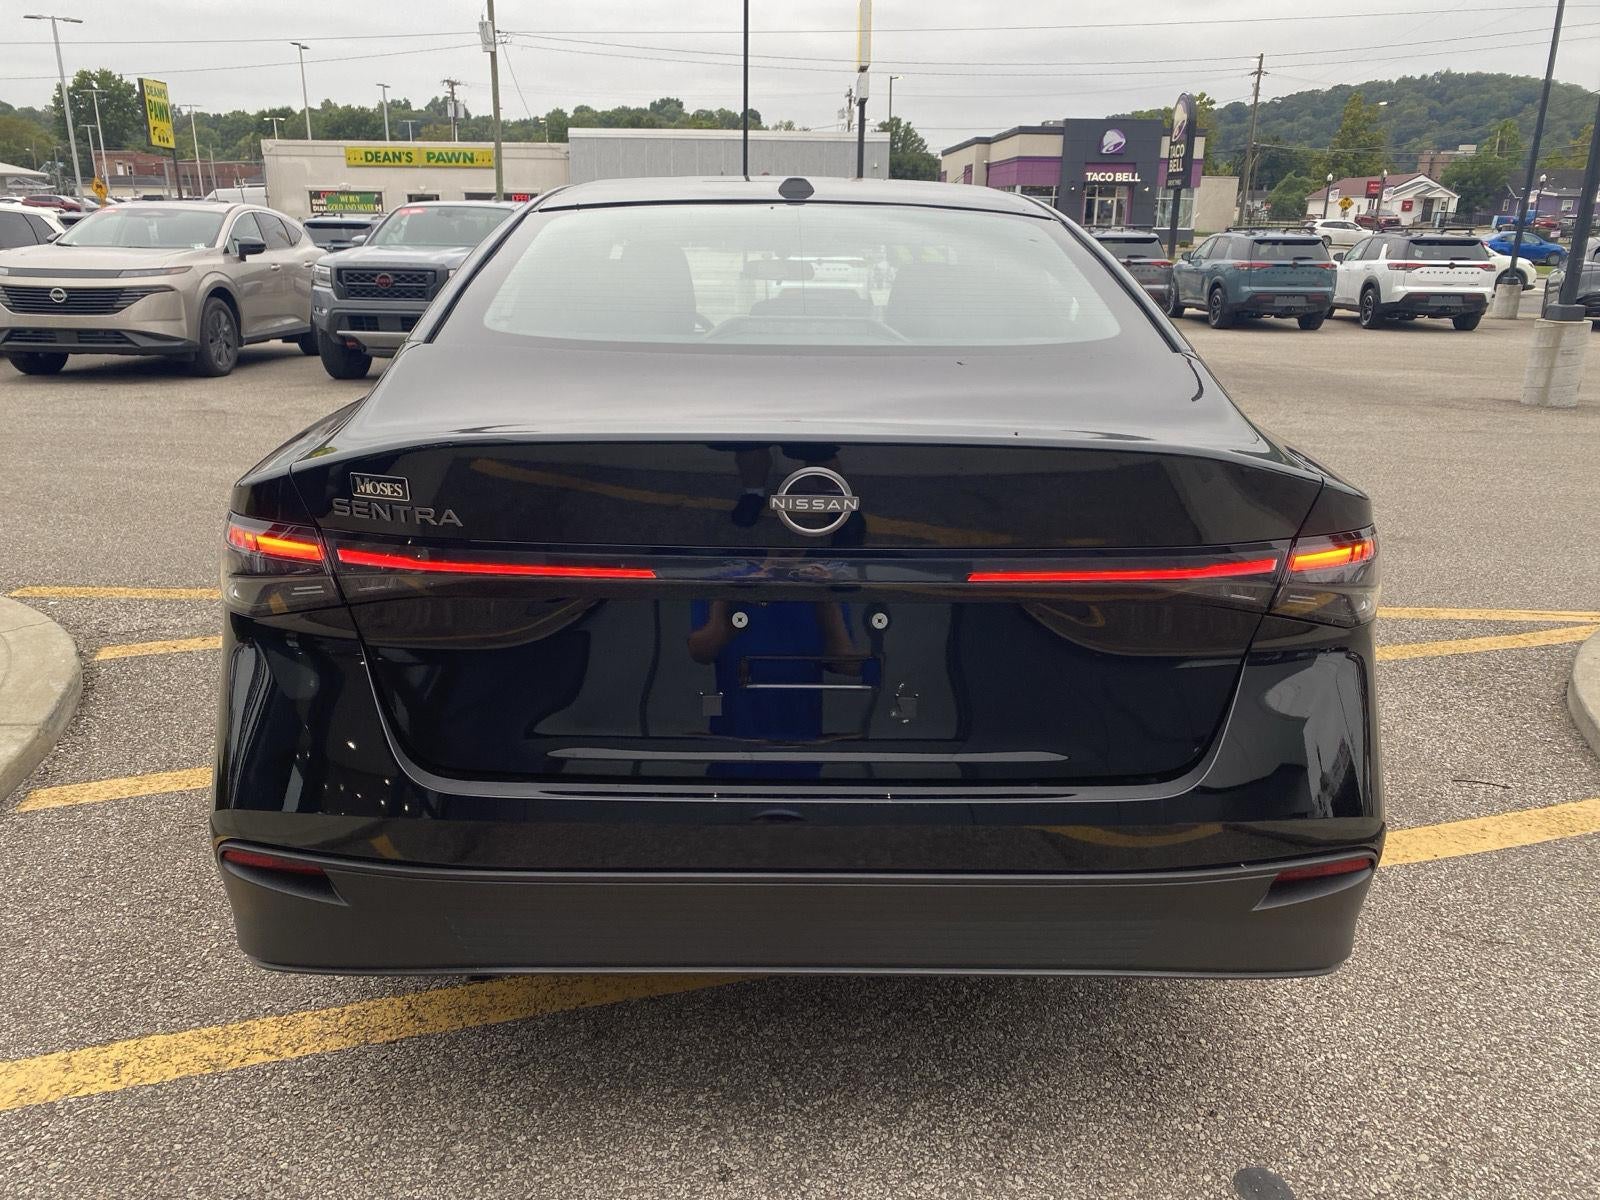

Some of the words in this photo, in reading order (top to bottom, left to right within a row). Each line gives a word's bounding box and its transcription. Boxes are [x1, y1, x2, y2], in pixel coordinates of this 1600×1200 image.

[148, 99, 170, 123] PAWN
[364, 151, 413, 163] DEAN'S
[426, 151, 475, 164] PAWN
[1170, 143, 1185, 158] TACO
[1168, 158, 1183, 173] BELL
[1086, 172, 1114, 182] TACO
[1115, 172, 1141, 182] BELL
[328, 203, 343, 211] GOLD
[357, 204, 374, 212] SILVER
[771, 498, 857, 511] NISSAN
[332, 497, 464, 527] SENTRA
